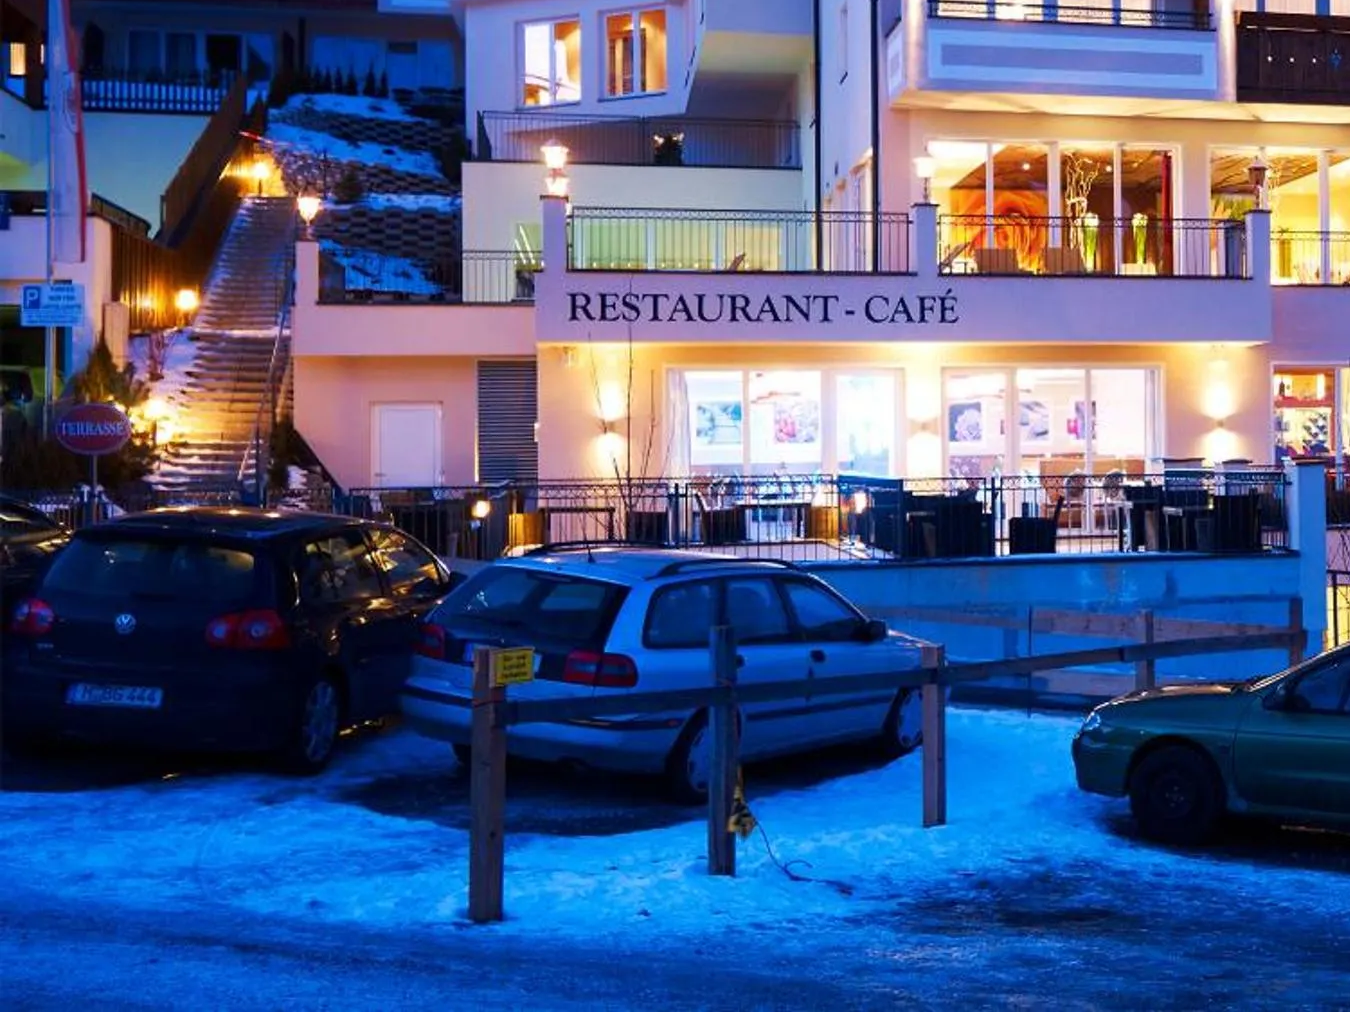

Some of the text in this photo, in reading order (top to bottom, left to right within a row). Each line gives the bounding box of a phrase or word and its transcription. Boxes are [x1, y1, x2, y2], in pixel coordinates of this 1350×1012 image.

[567, 292, 839, 323] RESTAURANT
[864, 289, 959, 324] CAFÉ
[61, 421, 125, 436] TERRASSE
